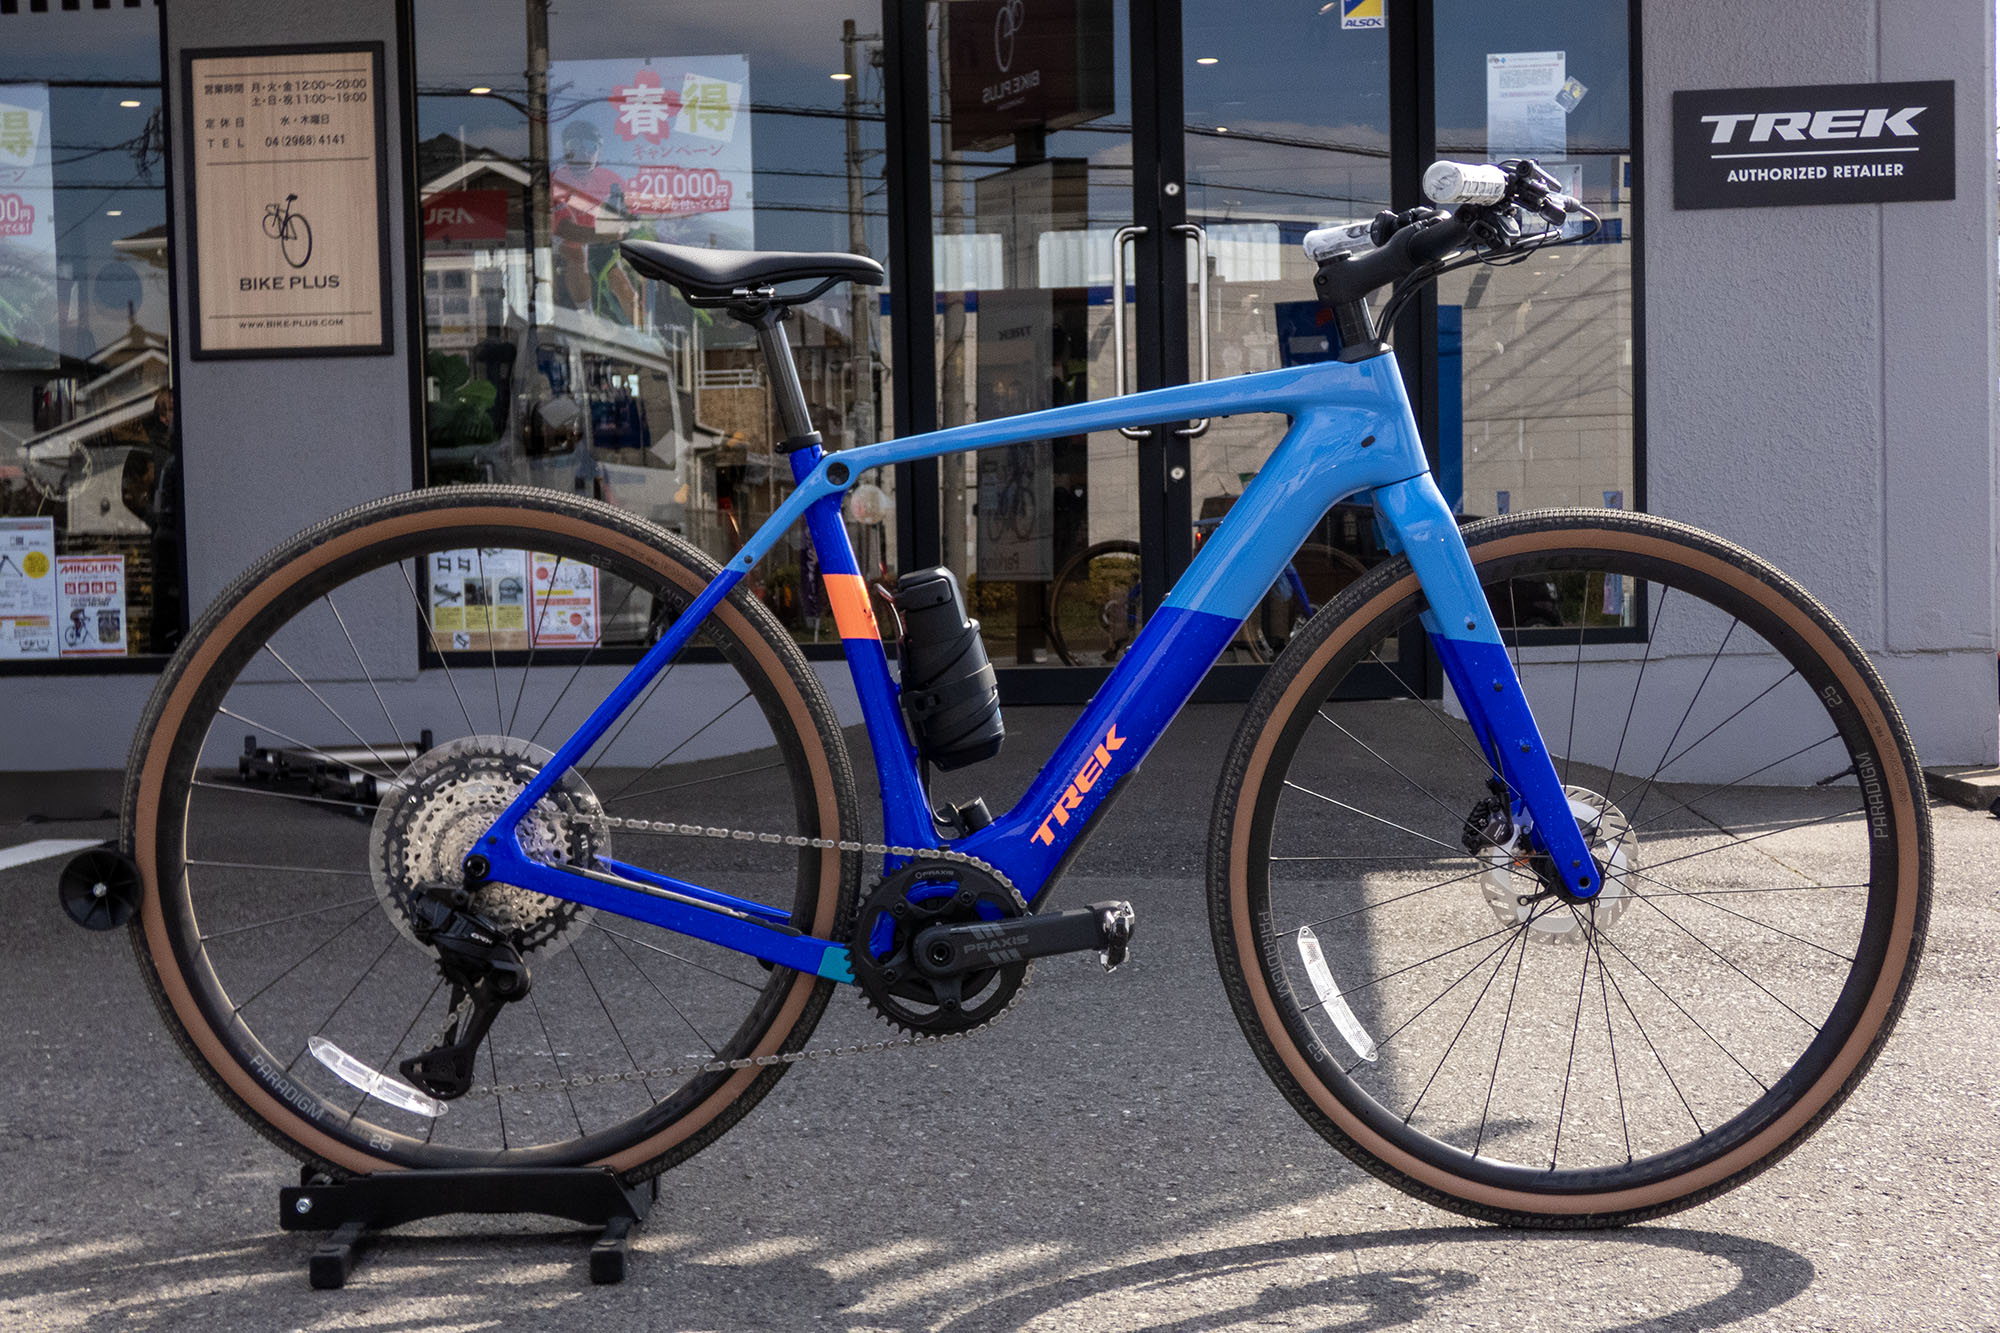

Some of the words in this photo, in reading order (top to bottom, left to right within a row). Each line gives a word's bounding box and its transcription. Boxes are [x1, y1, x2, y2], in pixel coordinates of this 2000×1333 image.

[1345, 18, 1382, 27] ALSOK
[1700, 106, 1928, 143] TREK
[633, 144, 724, 160] キャンペーン
[1727, 166, 1828, 182] AUTHORIZED
[1833, 163, 1904, 179] RETAILER
[239, 276, 285, 292] BIKE
[290, 275, 340, 289] PLUS
[60, 563, 120, 575] MINOURA
[1821, 685, 1844, 708] 25
[1030, 723, 1127, 846] TREK
[1855, 751, 1888, 839] PARADIGM
[963, 934, 1029, 954] PRAXIS
[1258, 911, 1291, 999] PARADIGM
[1306, 1039, 1325, 1063] 25
[249, 1055, 325, 1121] PARADIGM
[369, 1135, 393, 1152] 25
